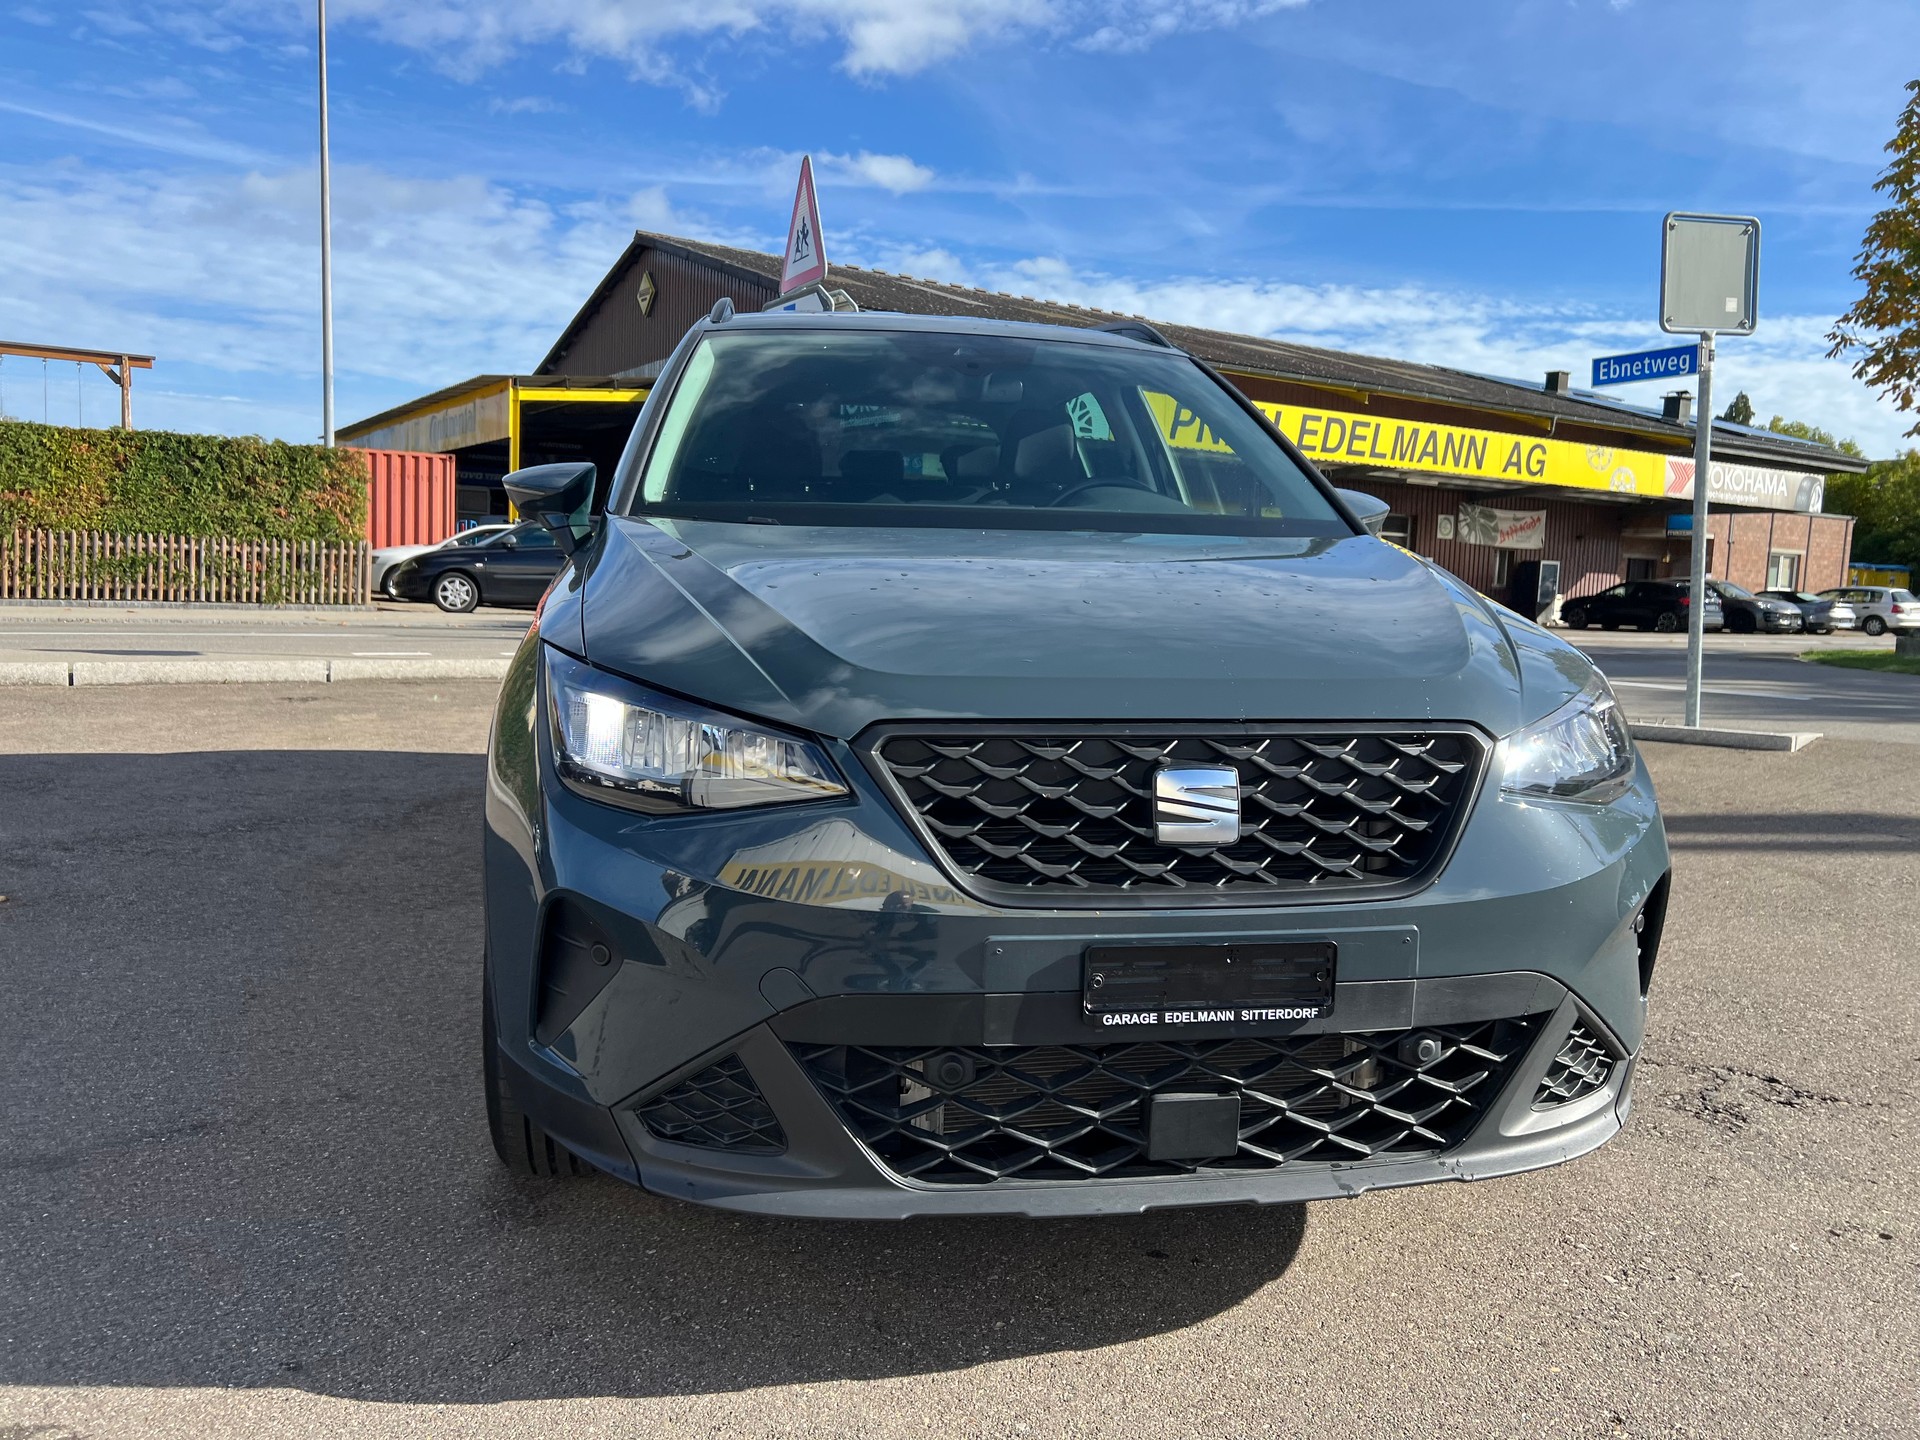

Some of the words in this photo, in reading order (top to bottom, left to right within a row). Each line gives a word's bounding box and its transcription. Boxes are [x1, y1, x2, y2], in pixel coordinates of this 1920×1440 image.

[1600, 353, 1690, 380] Ebnetweg
[1297, 413, 1488, 470] EDELMANN
[1502, 441, 1547, 477] AG
[1708, 465, 1788, 497] OKOHAMA
[1102, 1012, 1158, 1026] GARAGE
[1164, 1010, 1235, 1024] EDELMANN
[1241, 1007, 1319, 1021] SITTERDORF
